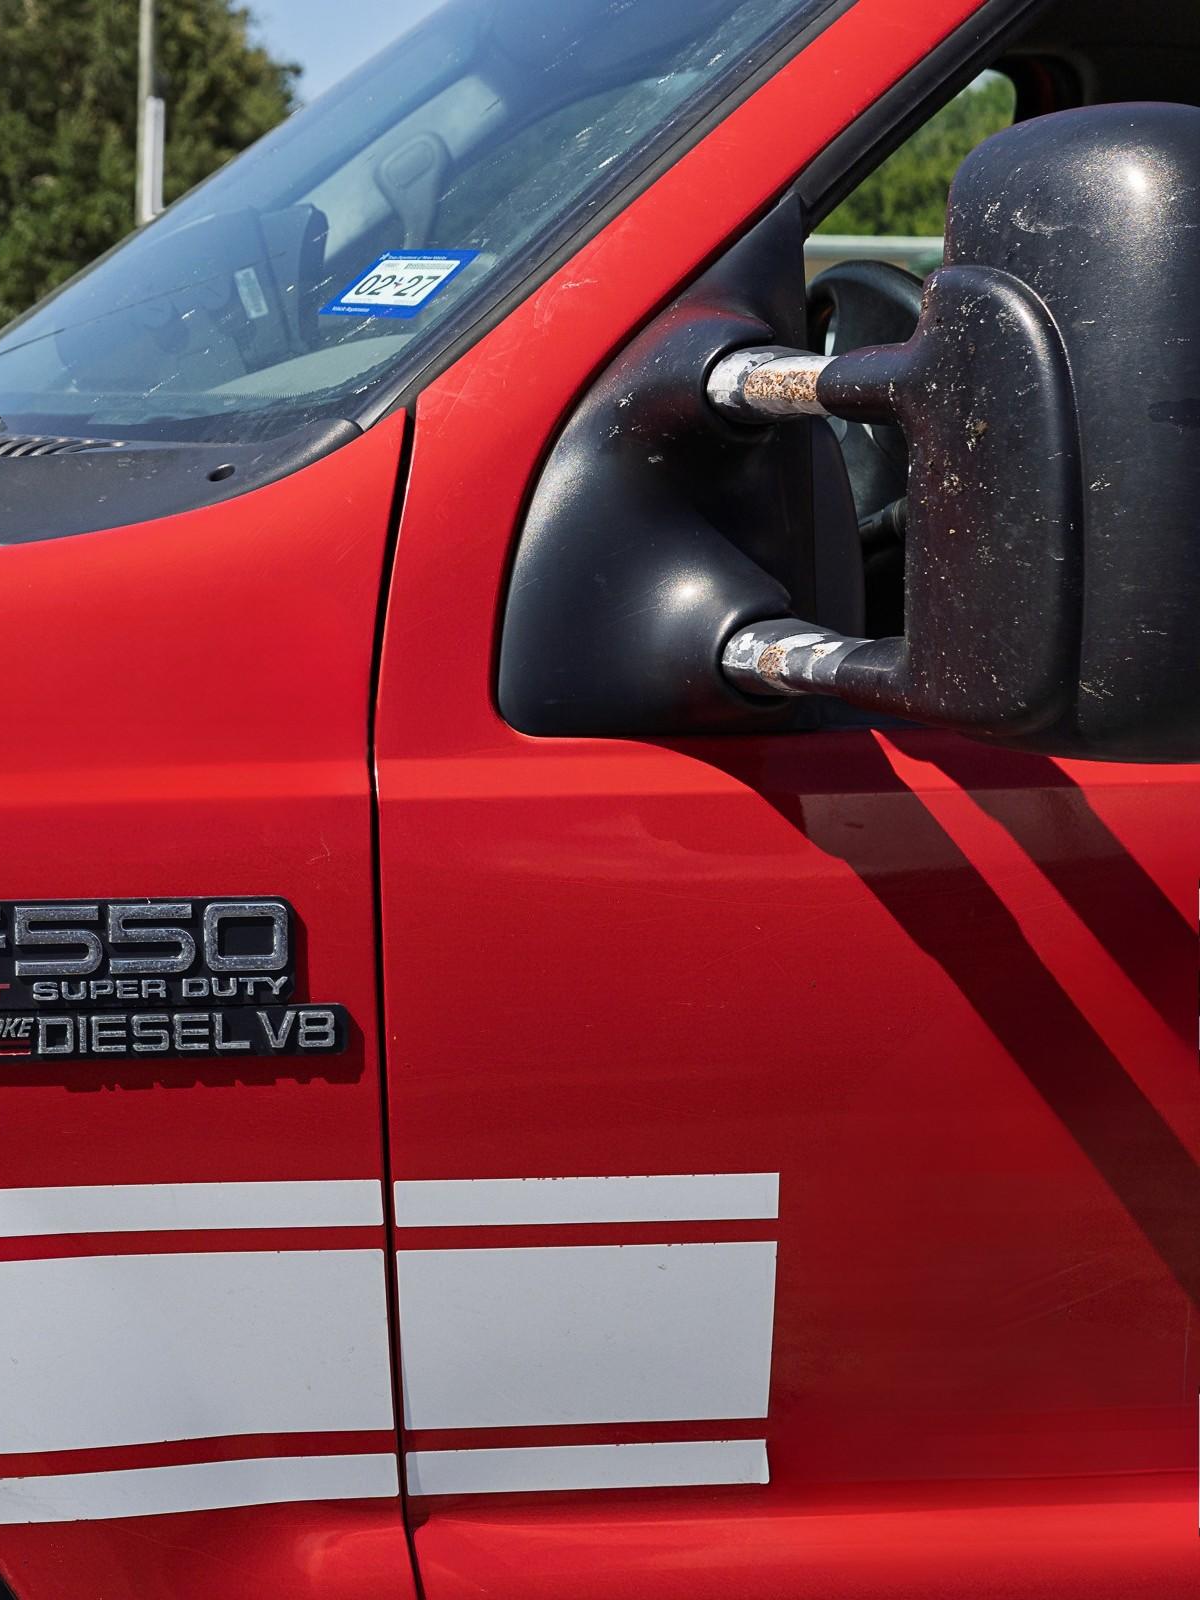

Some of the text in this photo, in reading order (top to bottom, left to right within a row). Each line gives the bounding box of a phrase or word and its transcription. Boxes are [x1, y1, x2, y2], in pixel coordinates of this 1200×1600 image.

[32, 976, 289, 1002] SUPER DUTY
[37, 1010, 336, 1054] DIESEL V8
